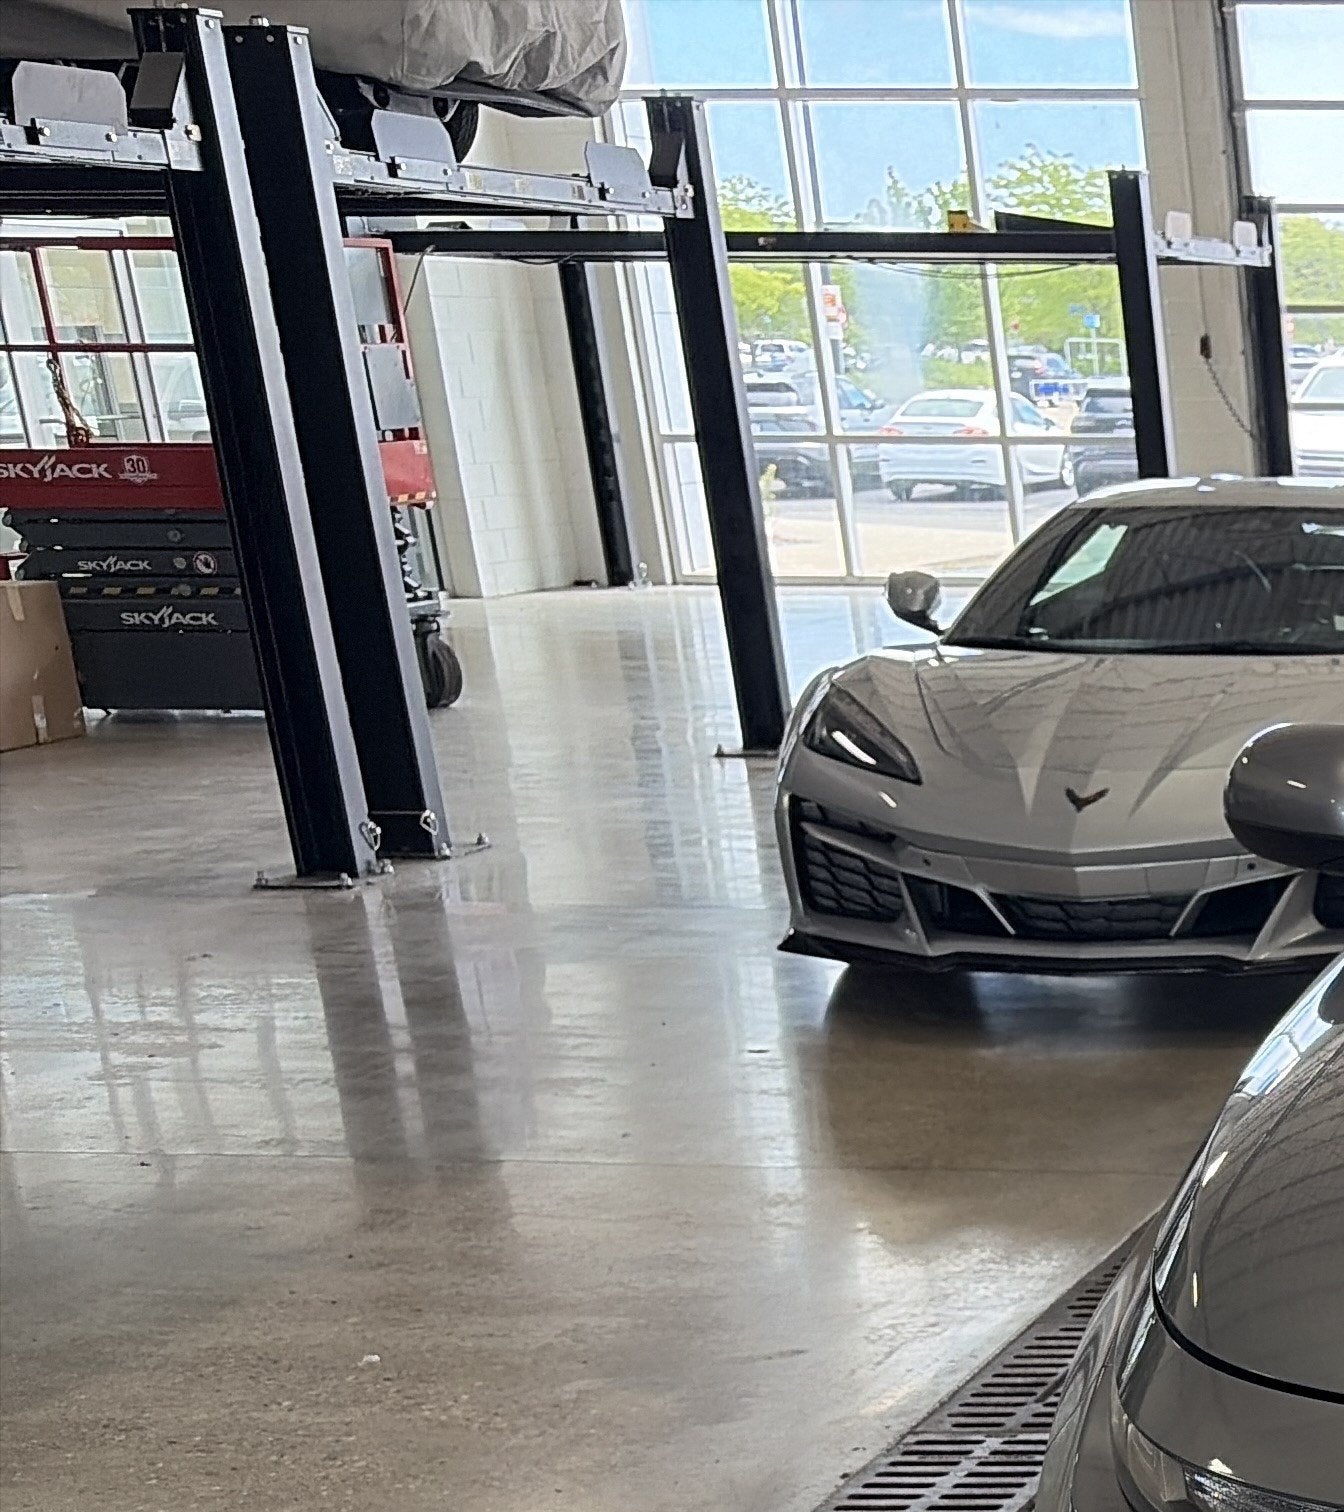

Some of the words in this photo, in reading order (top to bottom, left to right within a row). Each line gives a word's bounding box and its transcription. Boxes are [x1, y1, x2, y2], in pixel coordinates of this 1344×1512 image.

[126, 456, 146, 473] 30
[77, 555, 153, 573] SKYJACK
[120, 605, 219, 628] SKYJACK
